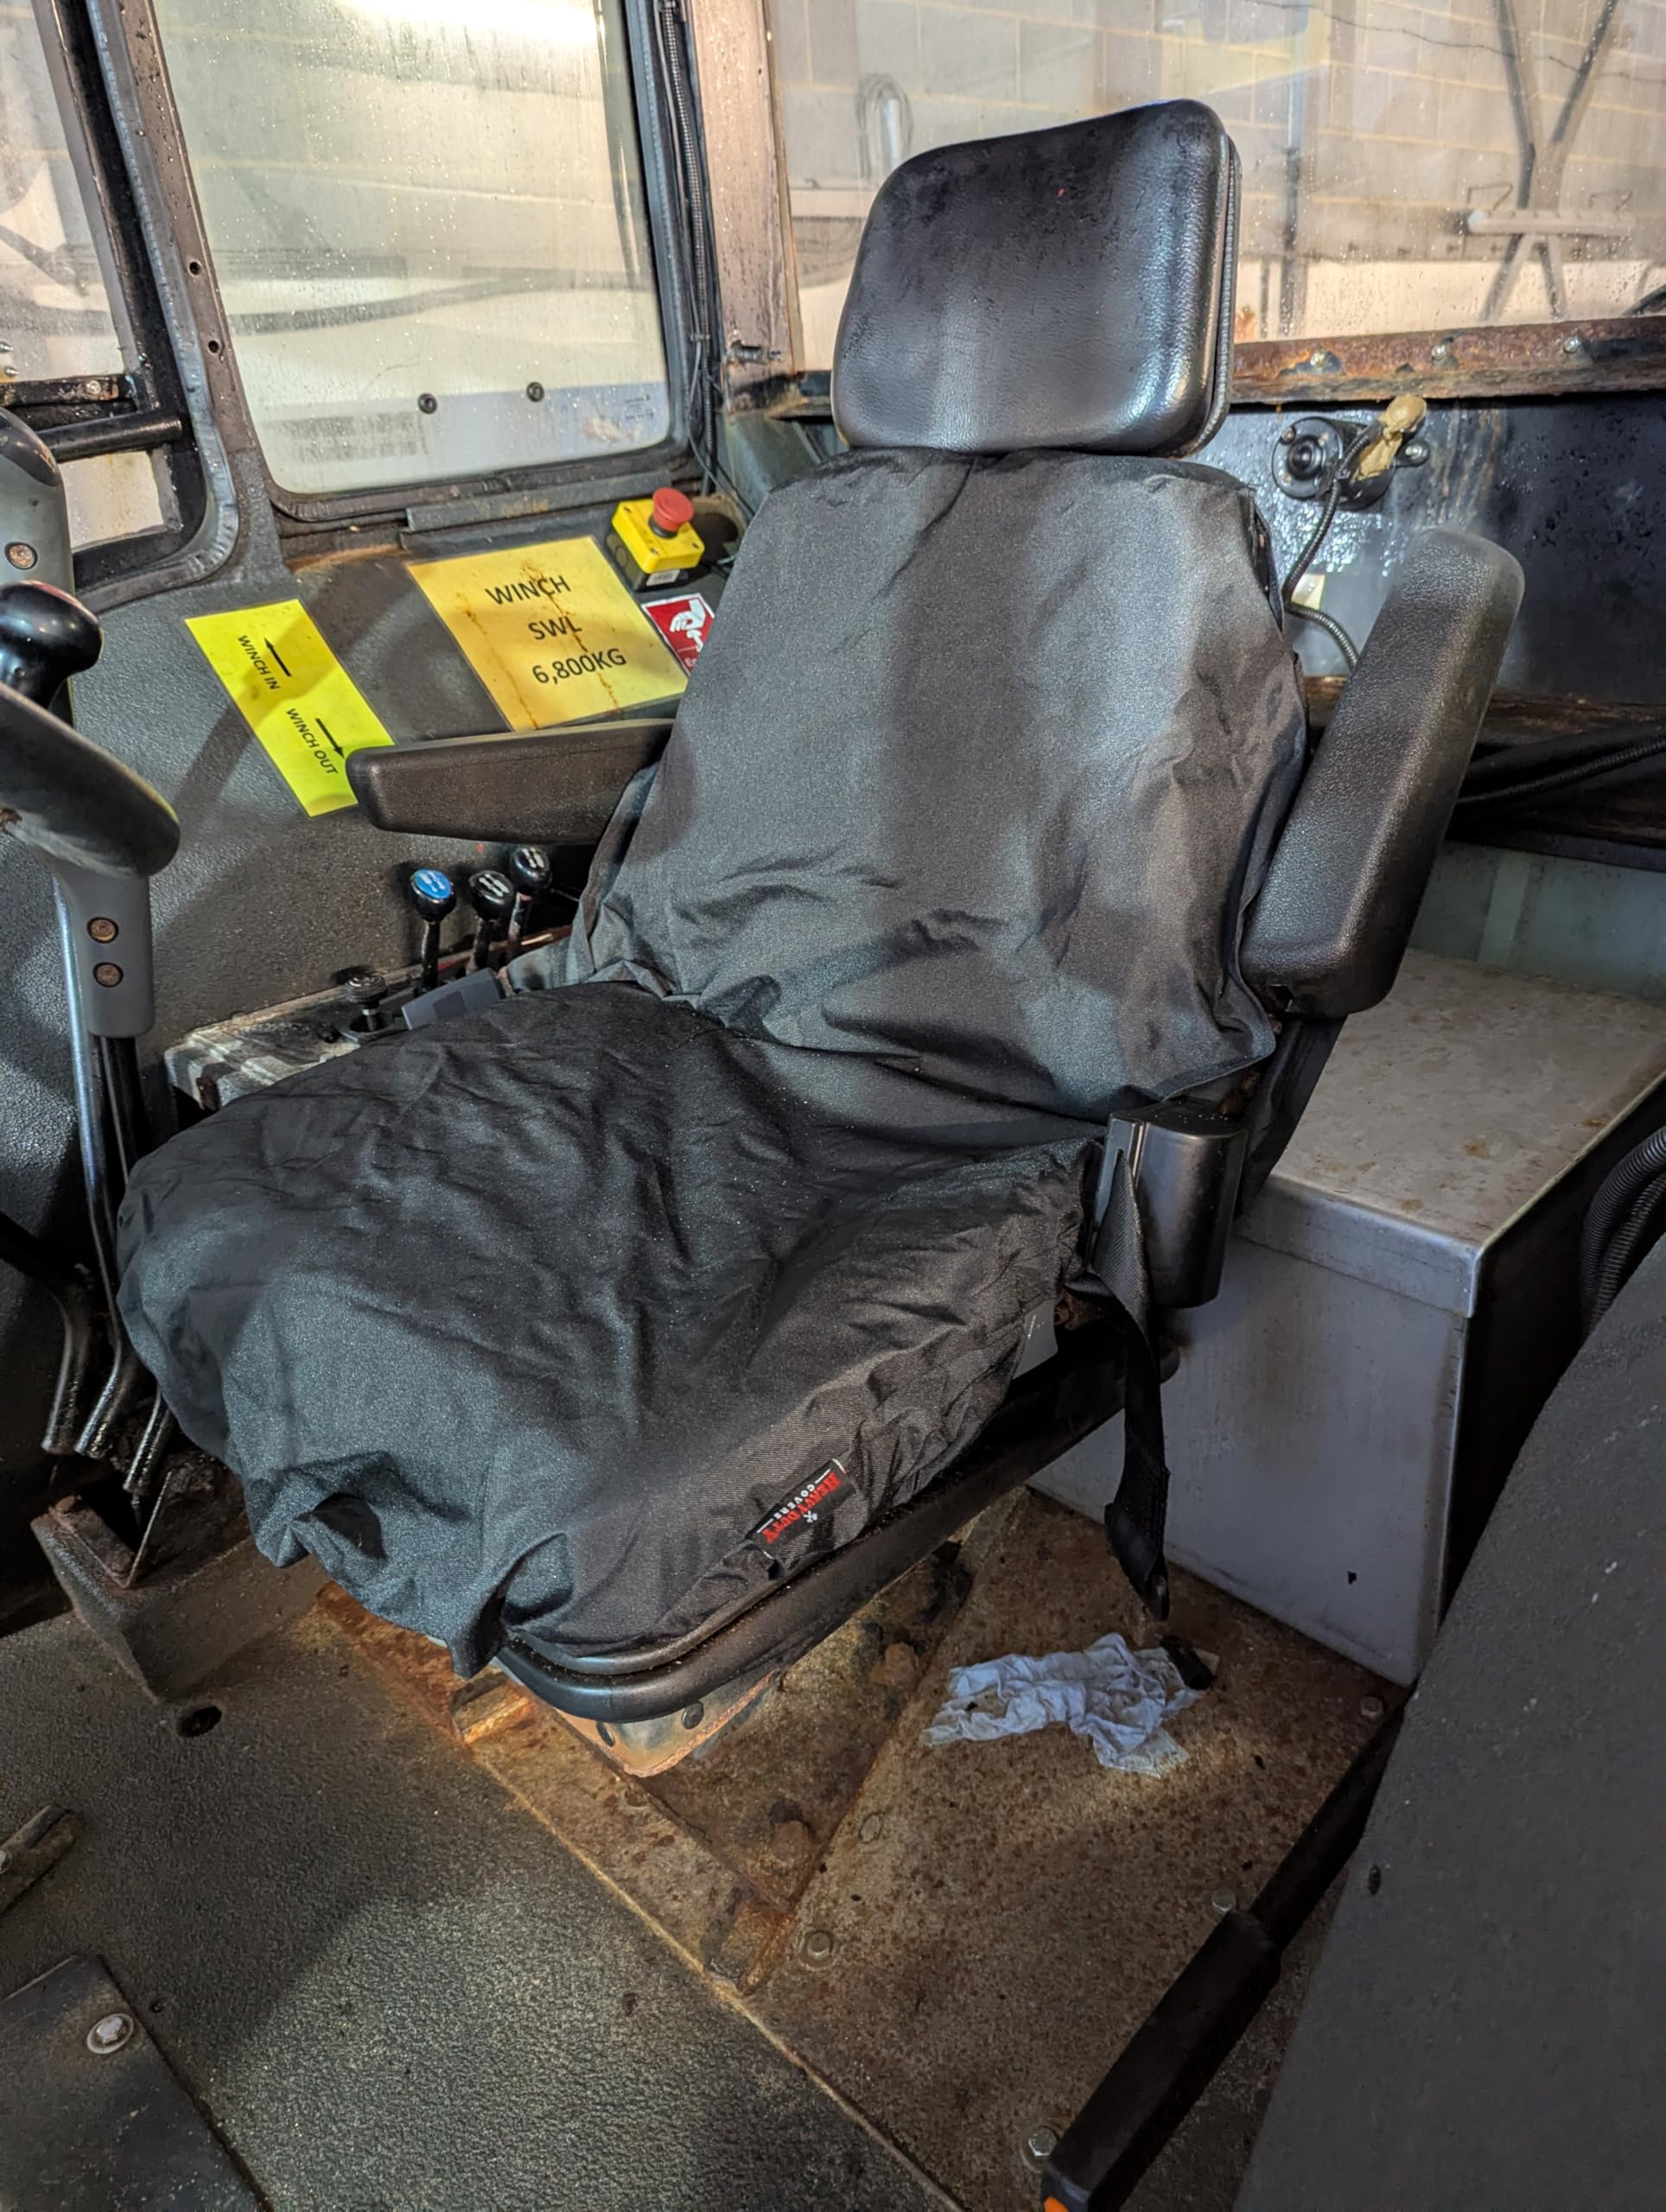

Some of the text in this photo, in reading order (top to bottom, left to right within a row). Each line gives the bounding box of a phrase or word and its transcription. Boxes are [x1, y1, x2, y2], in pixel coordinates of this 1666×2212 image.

[485, 575, 571, 605] WINCH
[528, 615, 582, 640] SWL
[238, 635, 281, 690] WINCH IN
[532, 647, 627, 684] 6,800KG
[286, 708, 339, 774] WINCH OUT
[762, 1471, 841, 1545] HEAVY DUTY
[773, 1484, 815, 1519] COVERS
